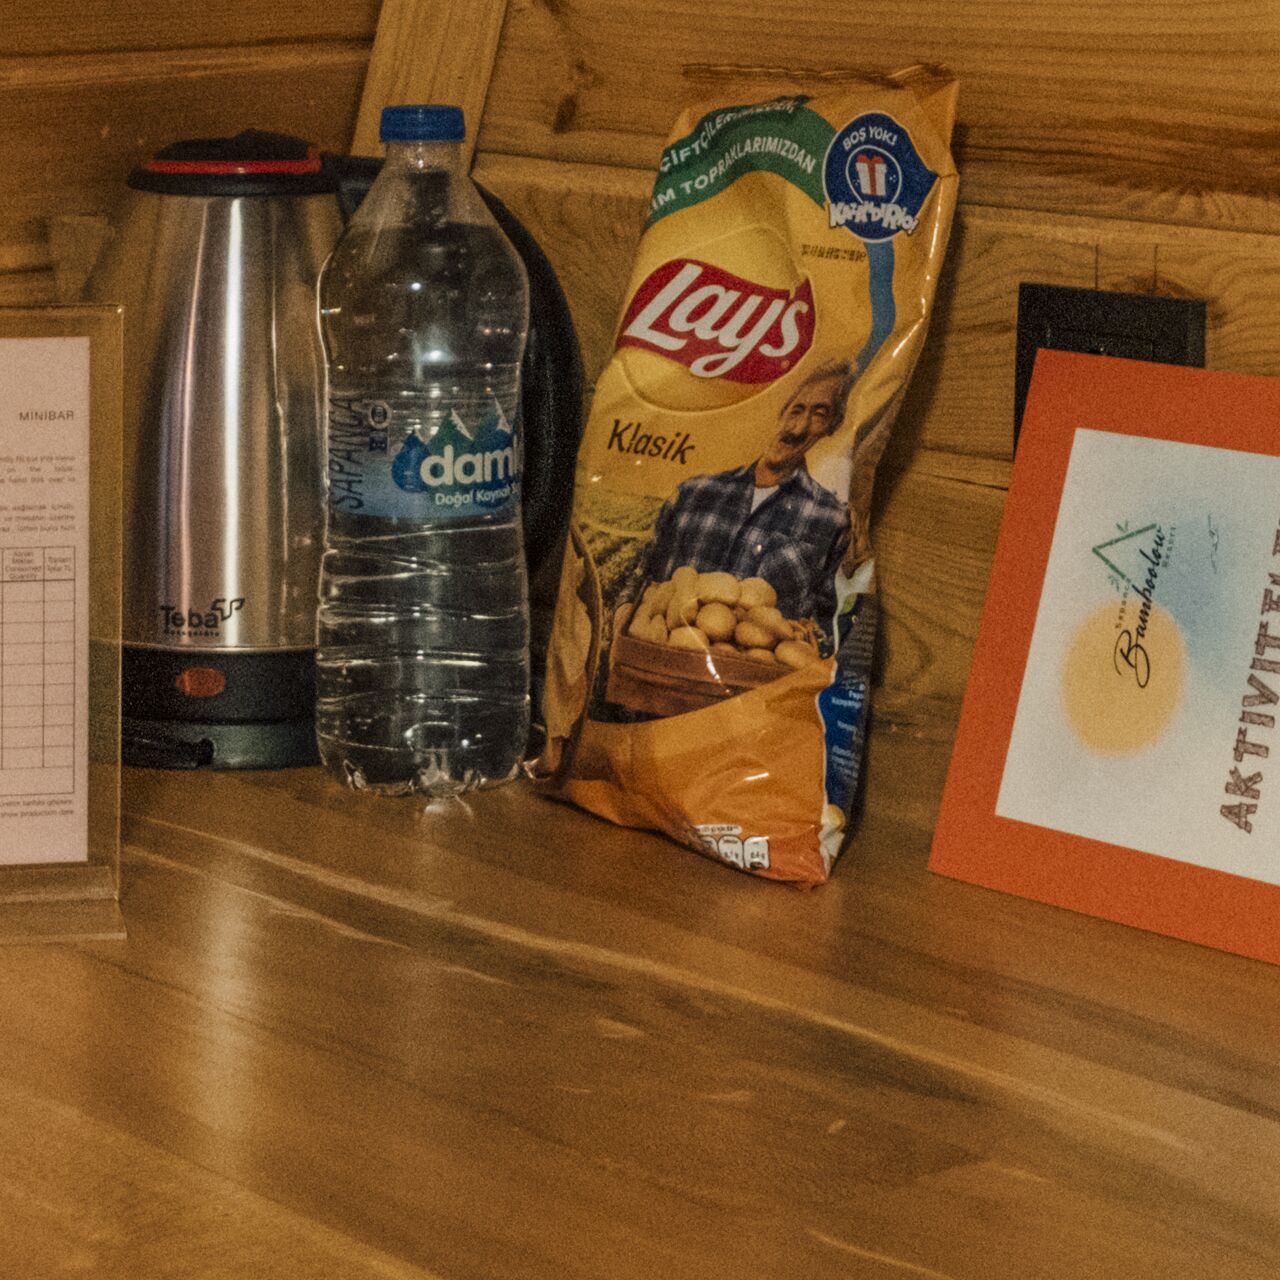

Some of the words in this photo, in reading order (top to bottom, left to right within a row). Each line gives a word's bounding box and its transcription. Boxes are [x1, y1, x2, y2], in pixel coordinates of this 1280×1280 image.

[842, 127, 867, 150] BOŞ
[869, 126, 897, 146] YOK!
[680, 136, 816, 195] TOPRAKLARIMIZDAN
[329, 398, 363, 509] SAPANCA
[607, 419, 695, 464] Klasik
[435, 491, 474, 507] Doğal
[160, 605, 218, 628] Teba
[1115, 525, 1171, 688] Bamboolow
